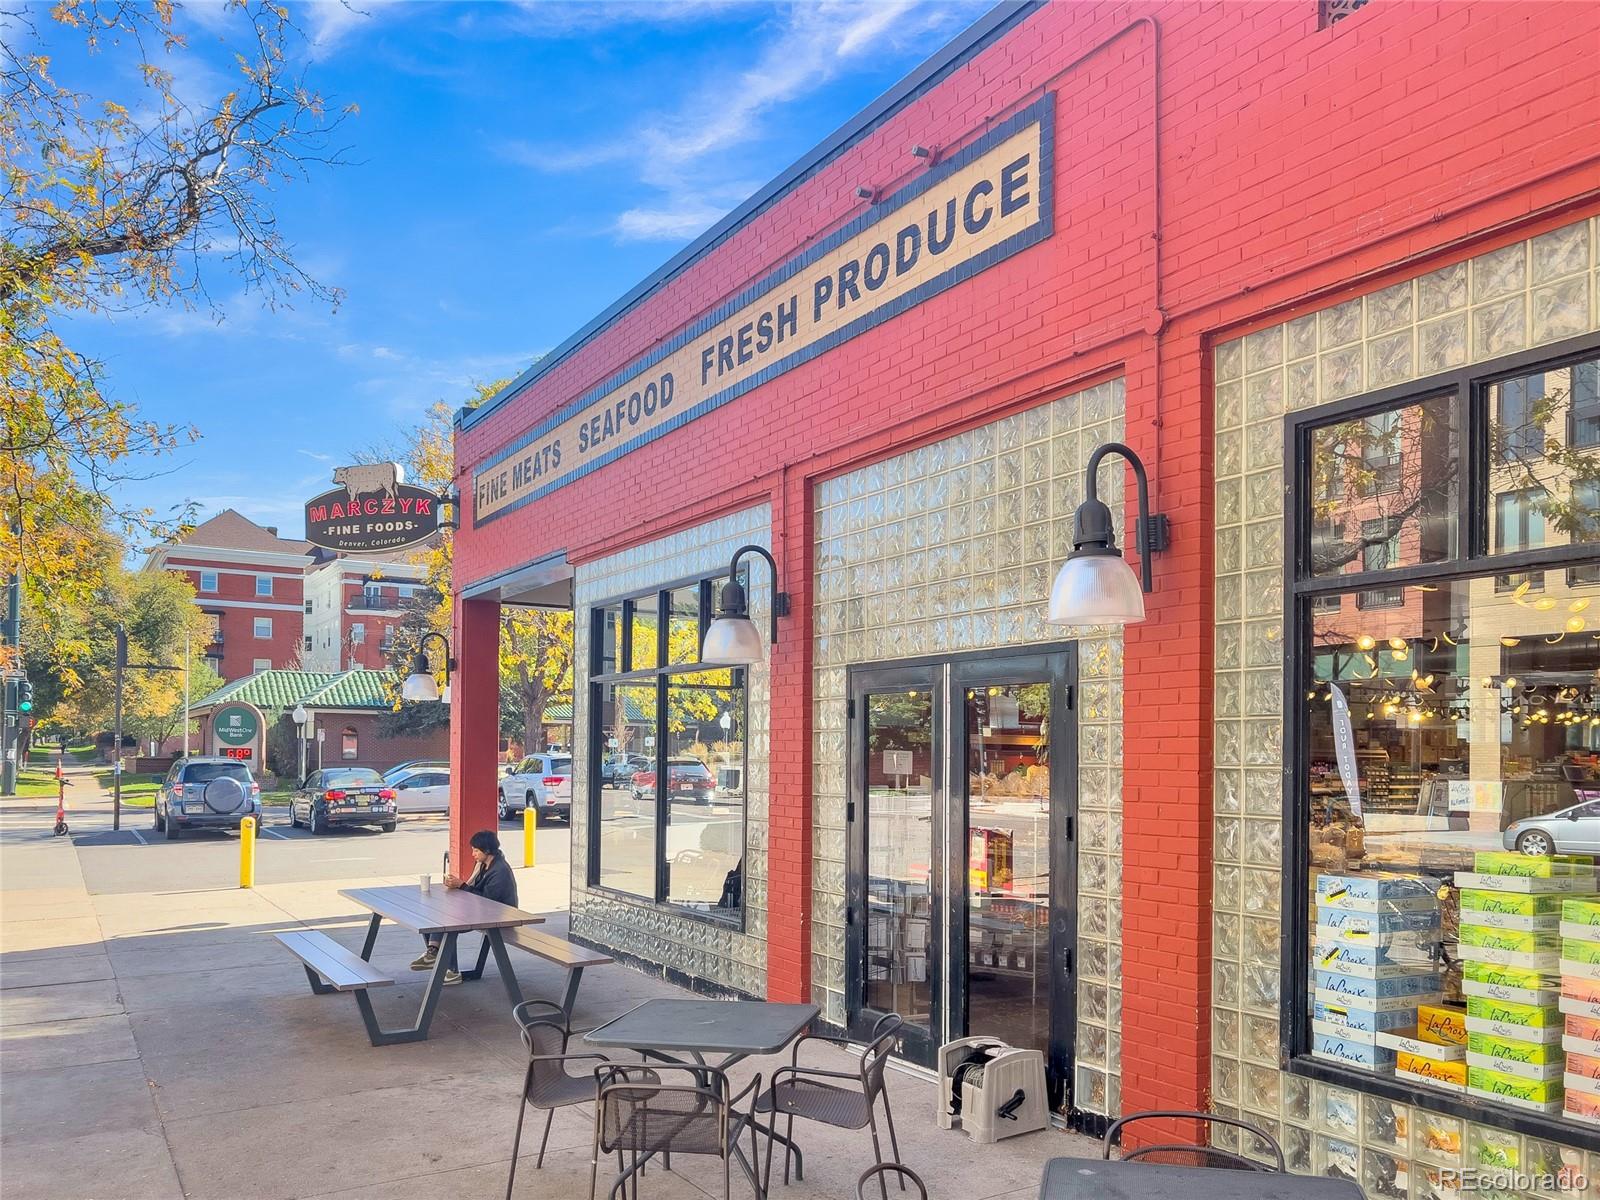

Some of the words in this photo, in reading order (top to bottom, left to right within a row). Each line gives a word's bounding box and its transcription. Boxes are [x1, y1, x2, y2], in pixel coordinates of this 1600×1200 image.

[479, 470, 508, 510] FINE
[512, 439, 561, 491] MEATS
[578, 372, 674, 453] SEAFOOD
[701, 294, 798, 387] FRESH
[813, 152, 1030, 324] PRODUCE
[309, 498, 431, 522] MARCZYK
[371, 536, 406, 546] Colorado
